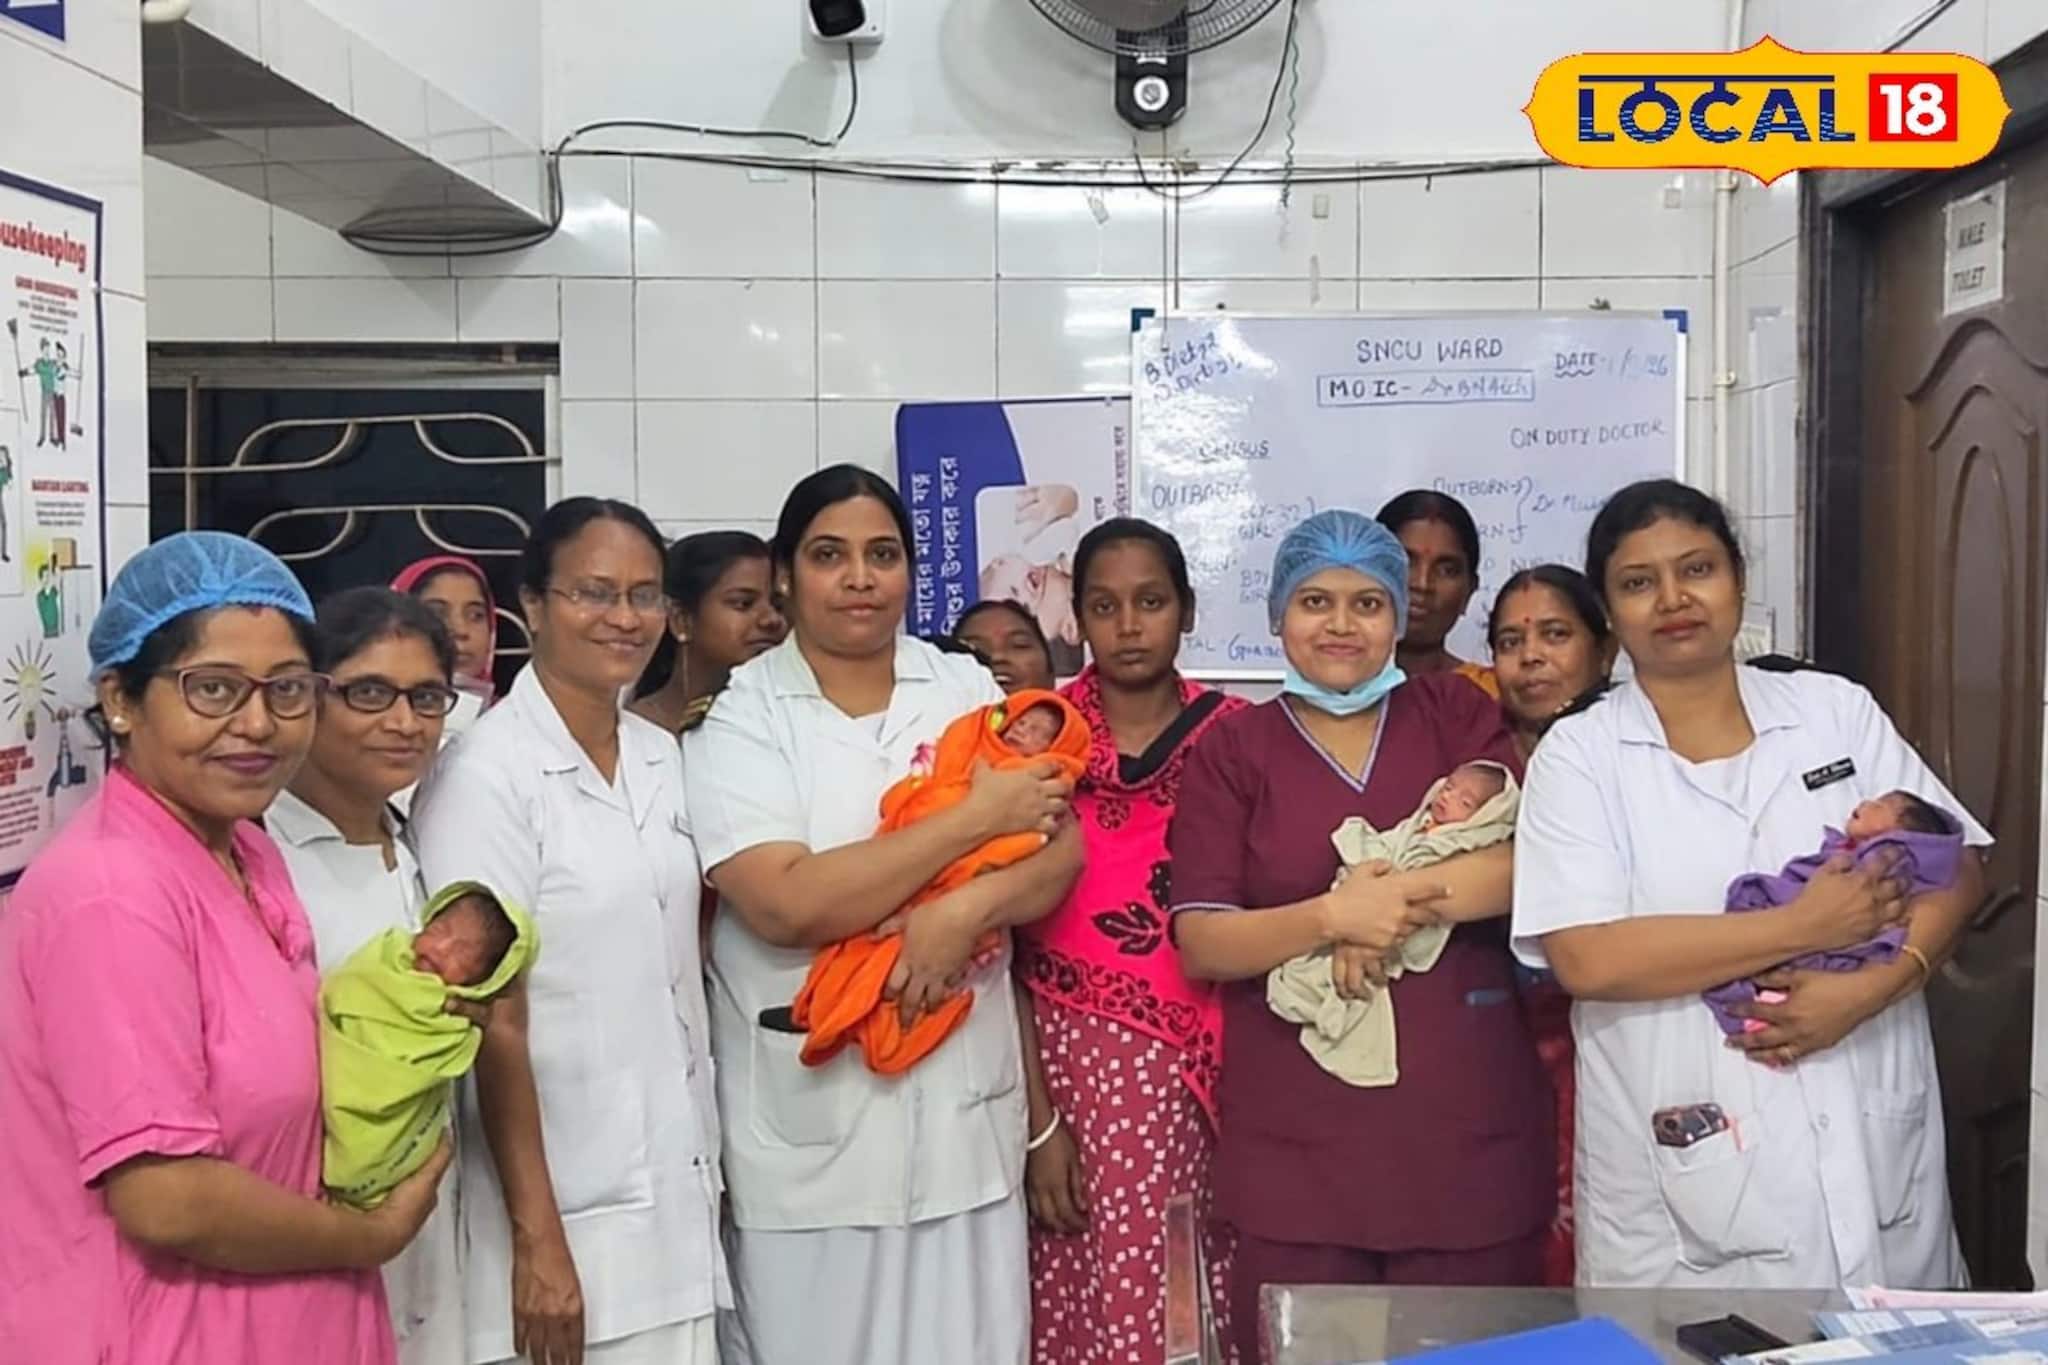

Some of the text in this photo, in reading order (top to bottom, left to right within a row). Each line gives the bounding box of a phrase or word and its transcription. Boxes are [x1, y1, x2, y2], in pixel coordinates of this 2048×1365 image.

[0, 221, 87, 272] usekeeping
[1356, 338, 1503, 364] SNCU WARD
[1510, 418, 1665, 448] ON DUTY DOCTOR
